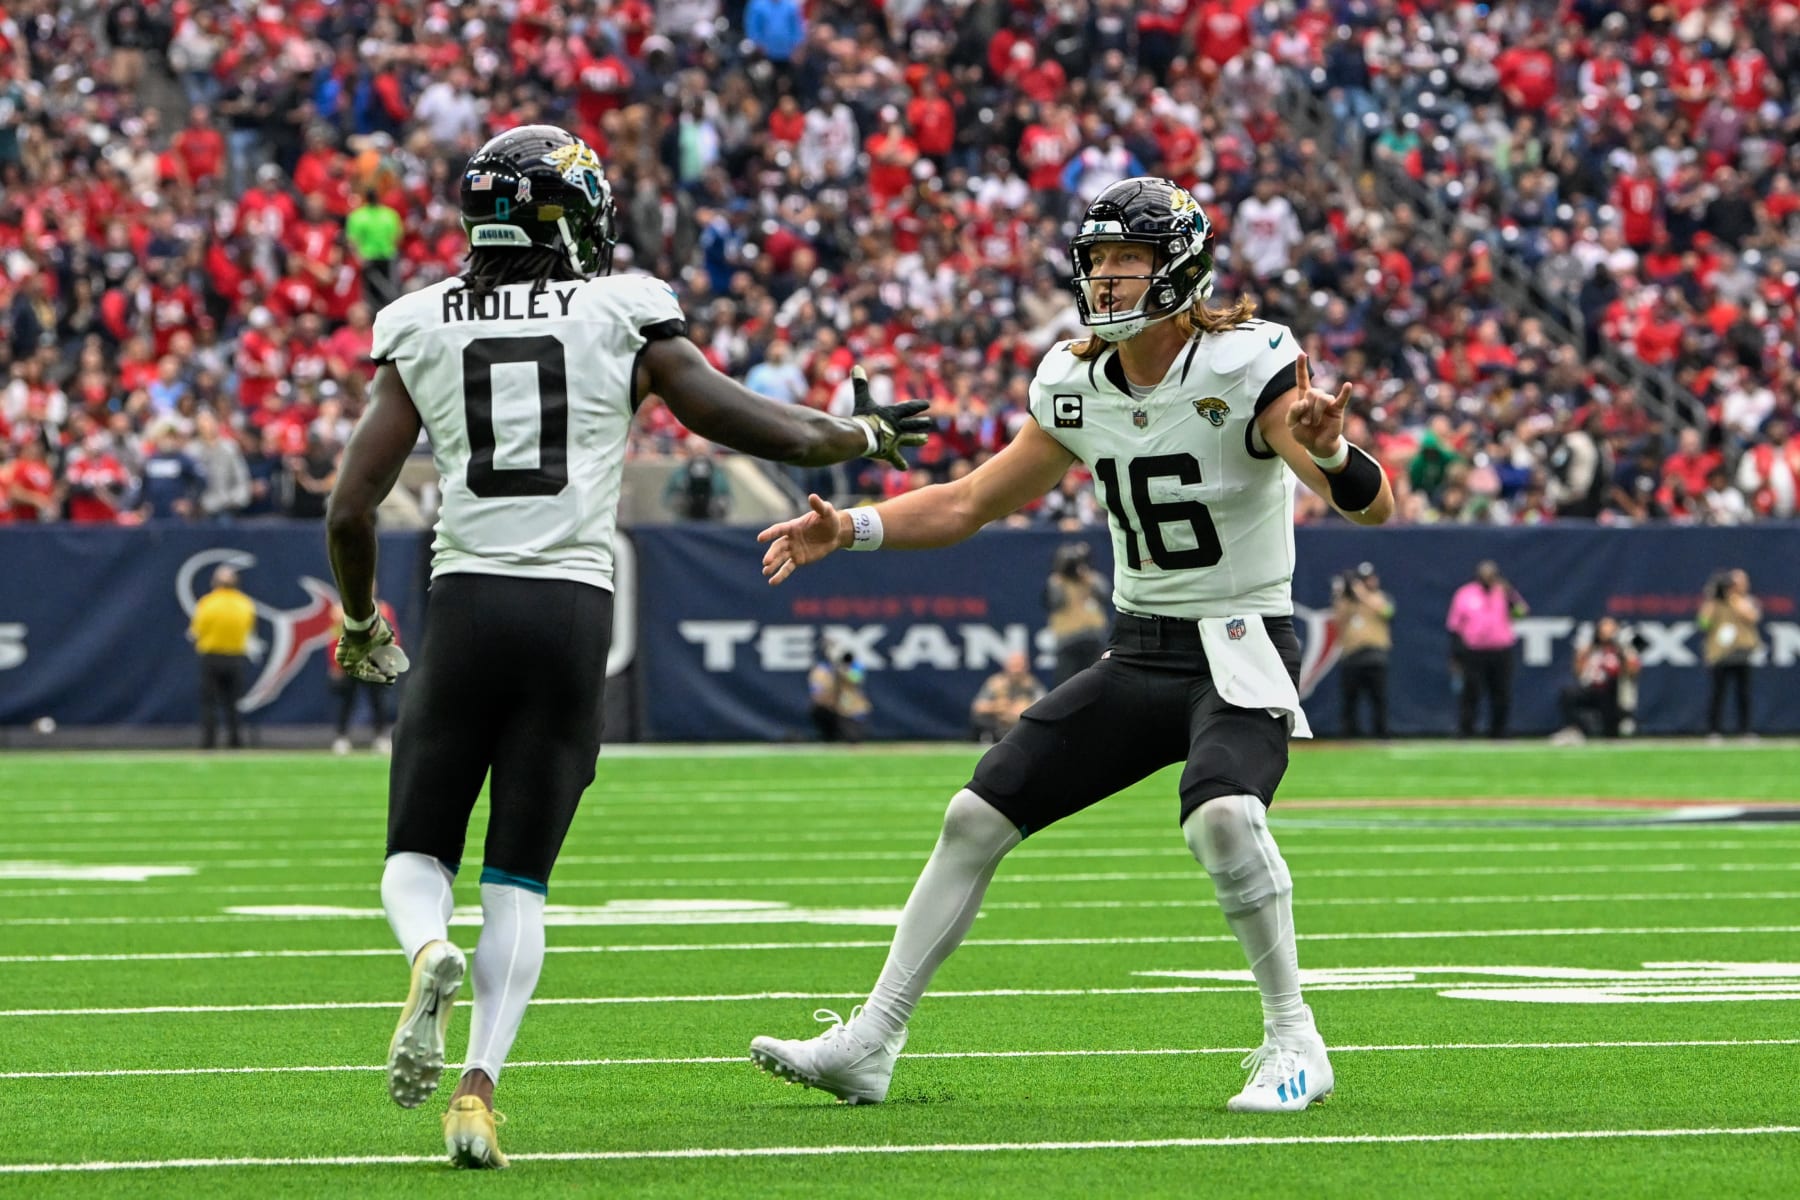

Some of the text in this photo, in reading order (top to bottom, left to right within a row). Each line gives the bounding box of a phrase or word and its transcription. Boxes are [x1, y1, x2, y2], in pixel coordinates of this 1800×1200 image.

[442, 286, 578, 323] RIDLEY
[463, 335, 569, 498] 0
[1055, 396, 1081, 420] C
[1095, 452, 1224, 571] 16
